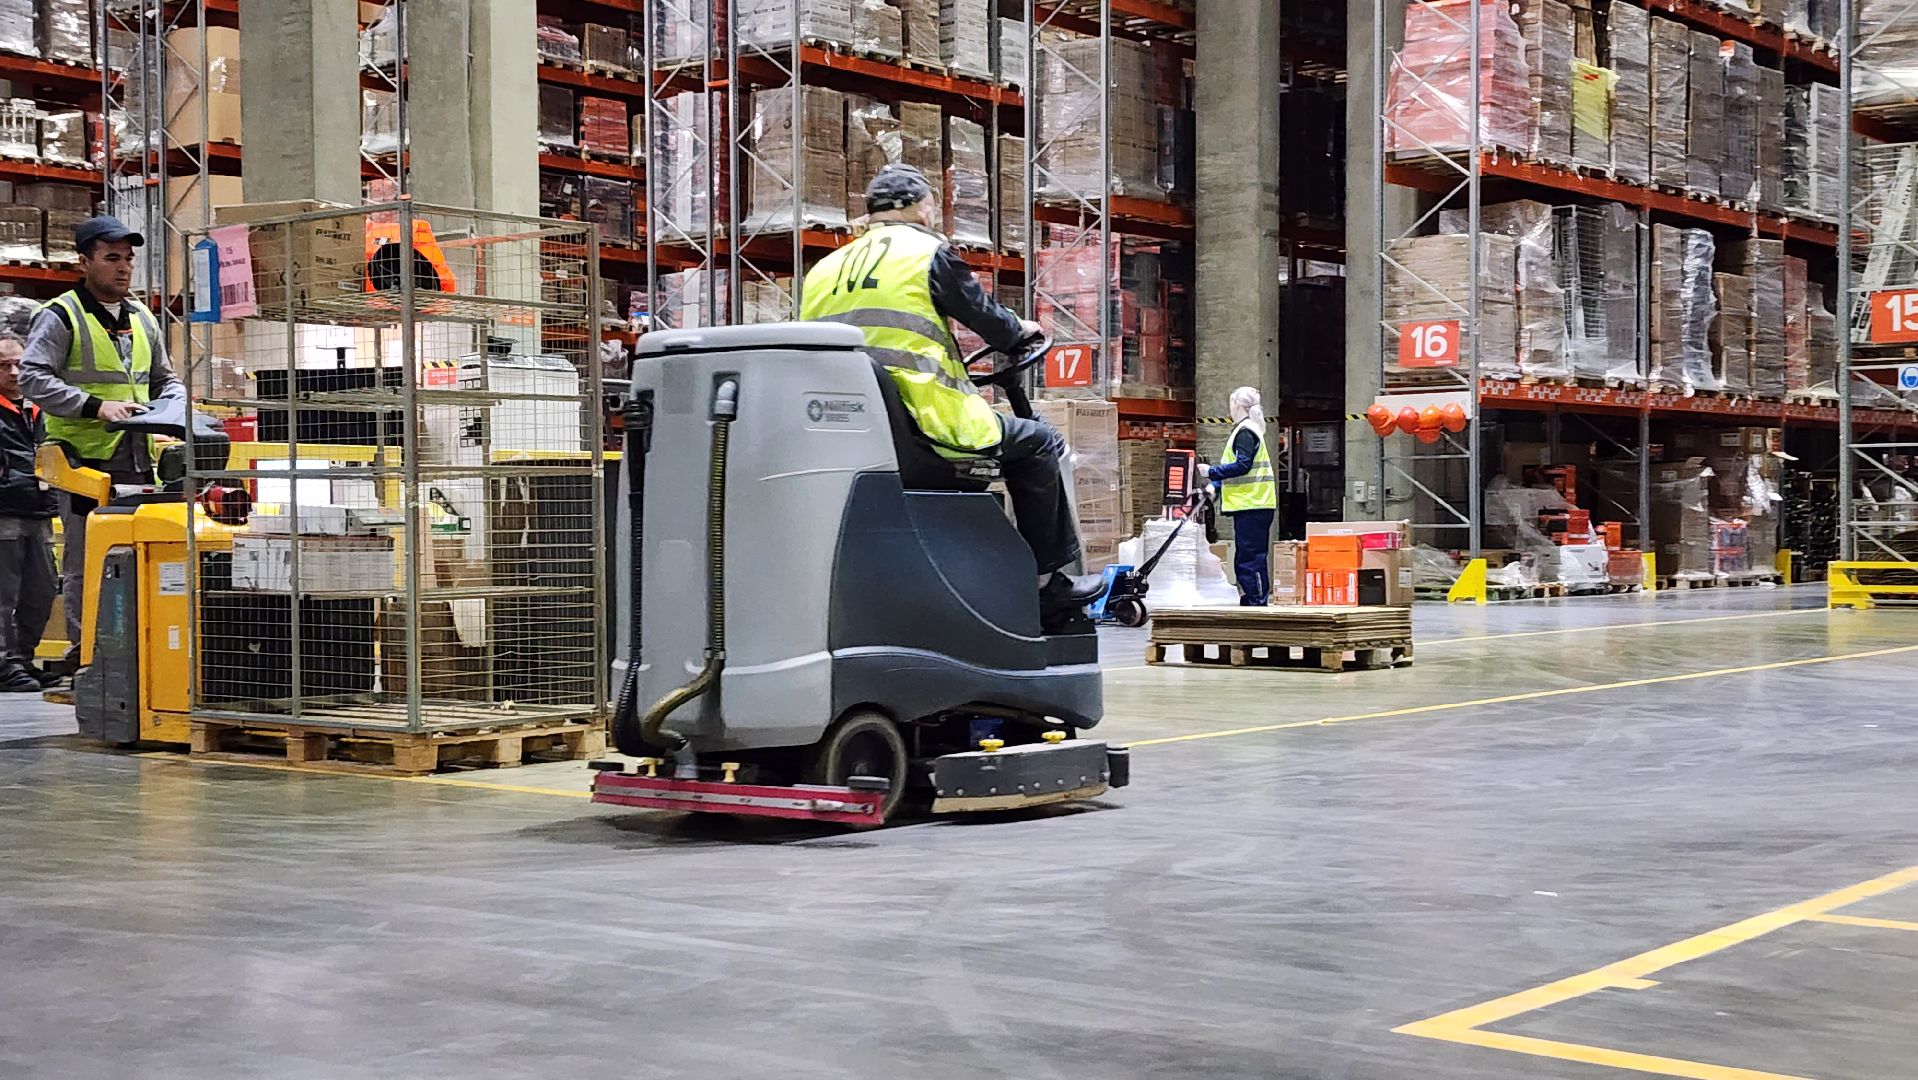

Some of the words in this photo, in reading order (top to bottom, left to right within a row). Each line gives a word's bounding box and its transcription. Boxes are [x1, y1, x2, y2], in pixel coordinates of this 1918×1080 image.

[832, 237, 892, 295] 102
[1410, 324, 1448, 358] 16
[1054, 348, 1082, 379] 17
